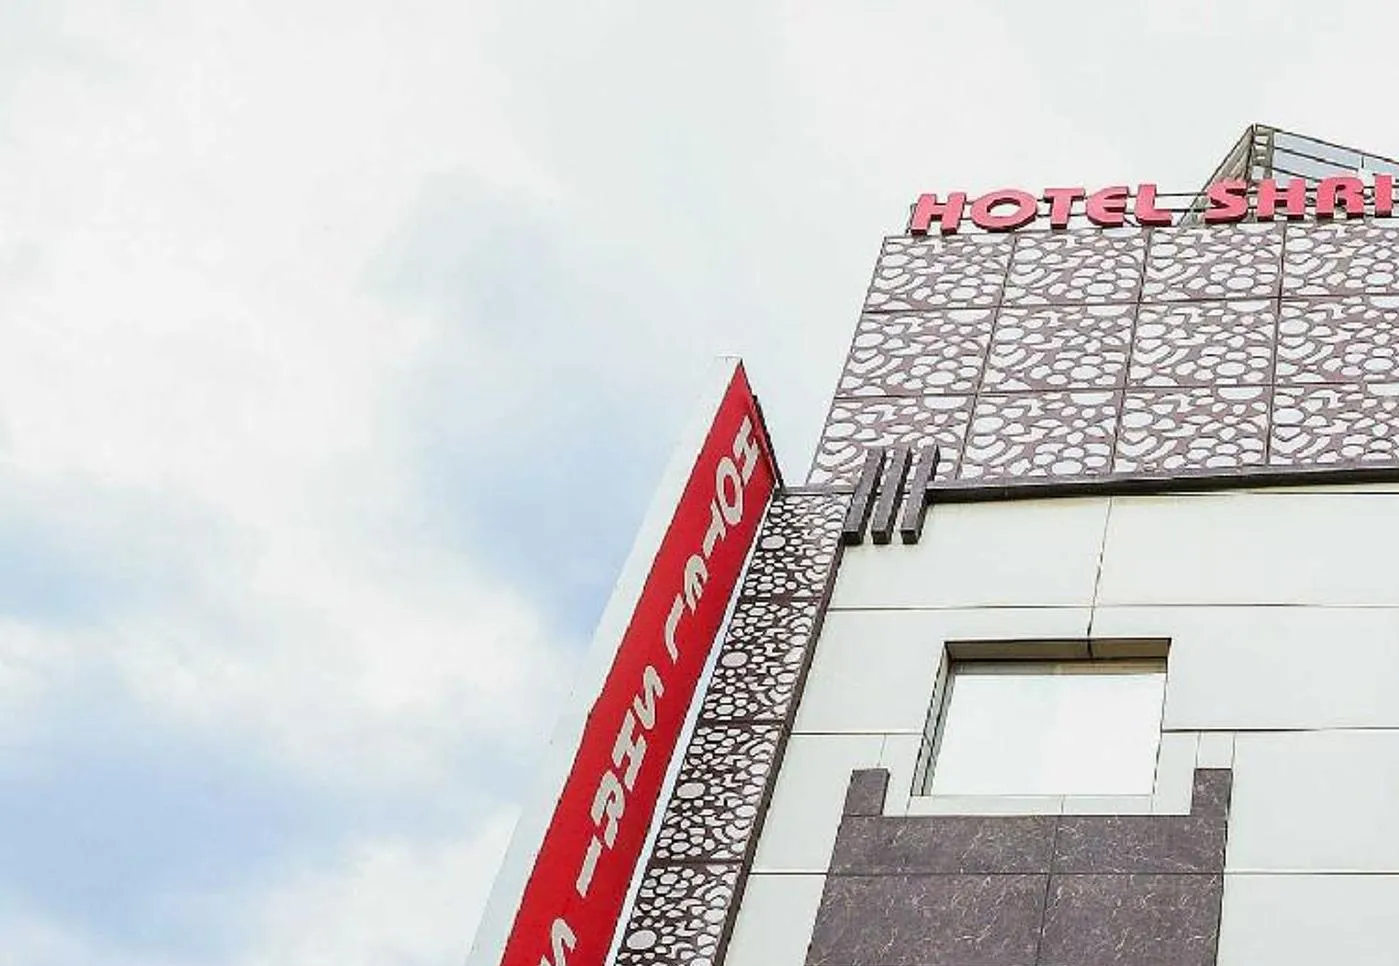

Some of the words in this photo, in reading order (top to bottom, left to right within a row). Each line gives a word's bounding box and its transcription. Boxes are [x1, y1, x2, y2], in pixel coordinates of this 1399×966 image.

[910, 183, 1174, 236] HOTEL
[1203, 172, 1395, 225] SHRI
[663, 415, 760, 668] HOTEL
[573, 661, 666, 900] SHRI
